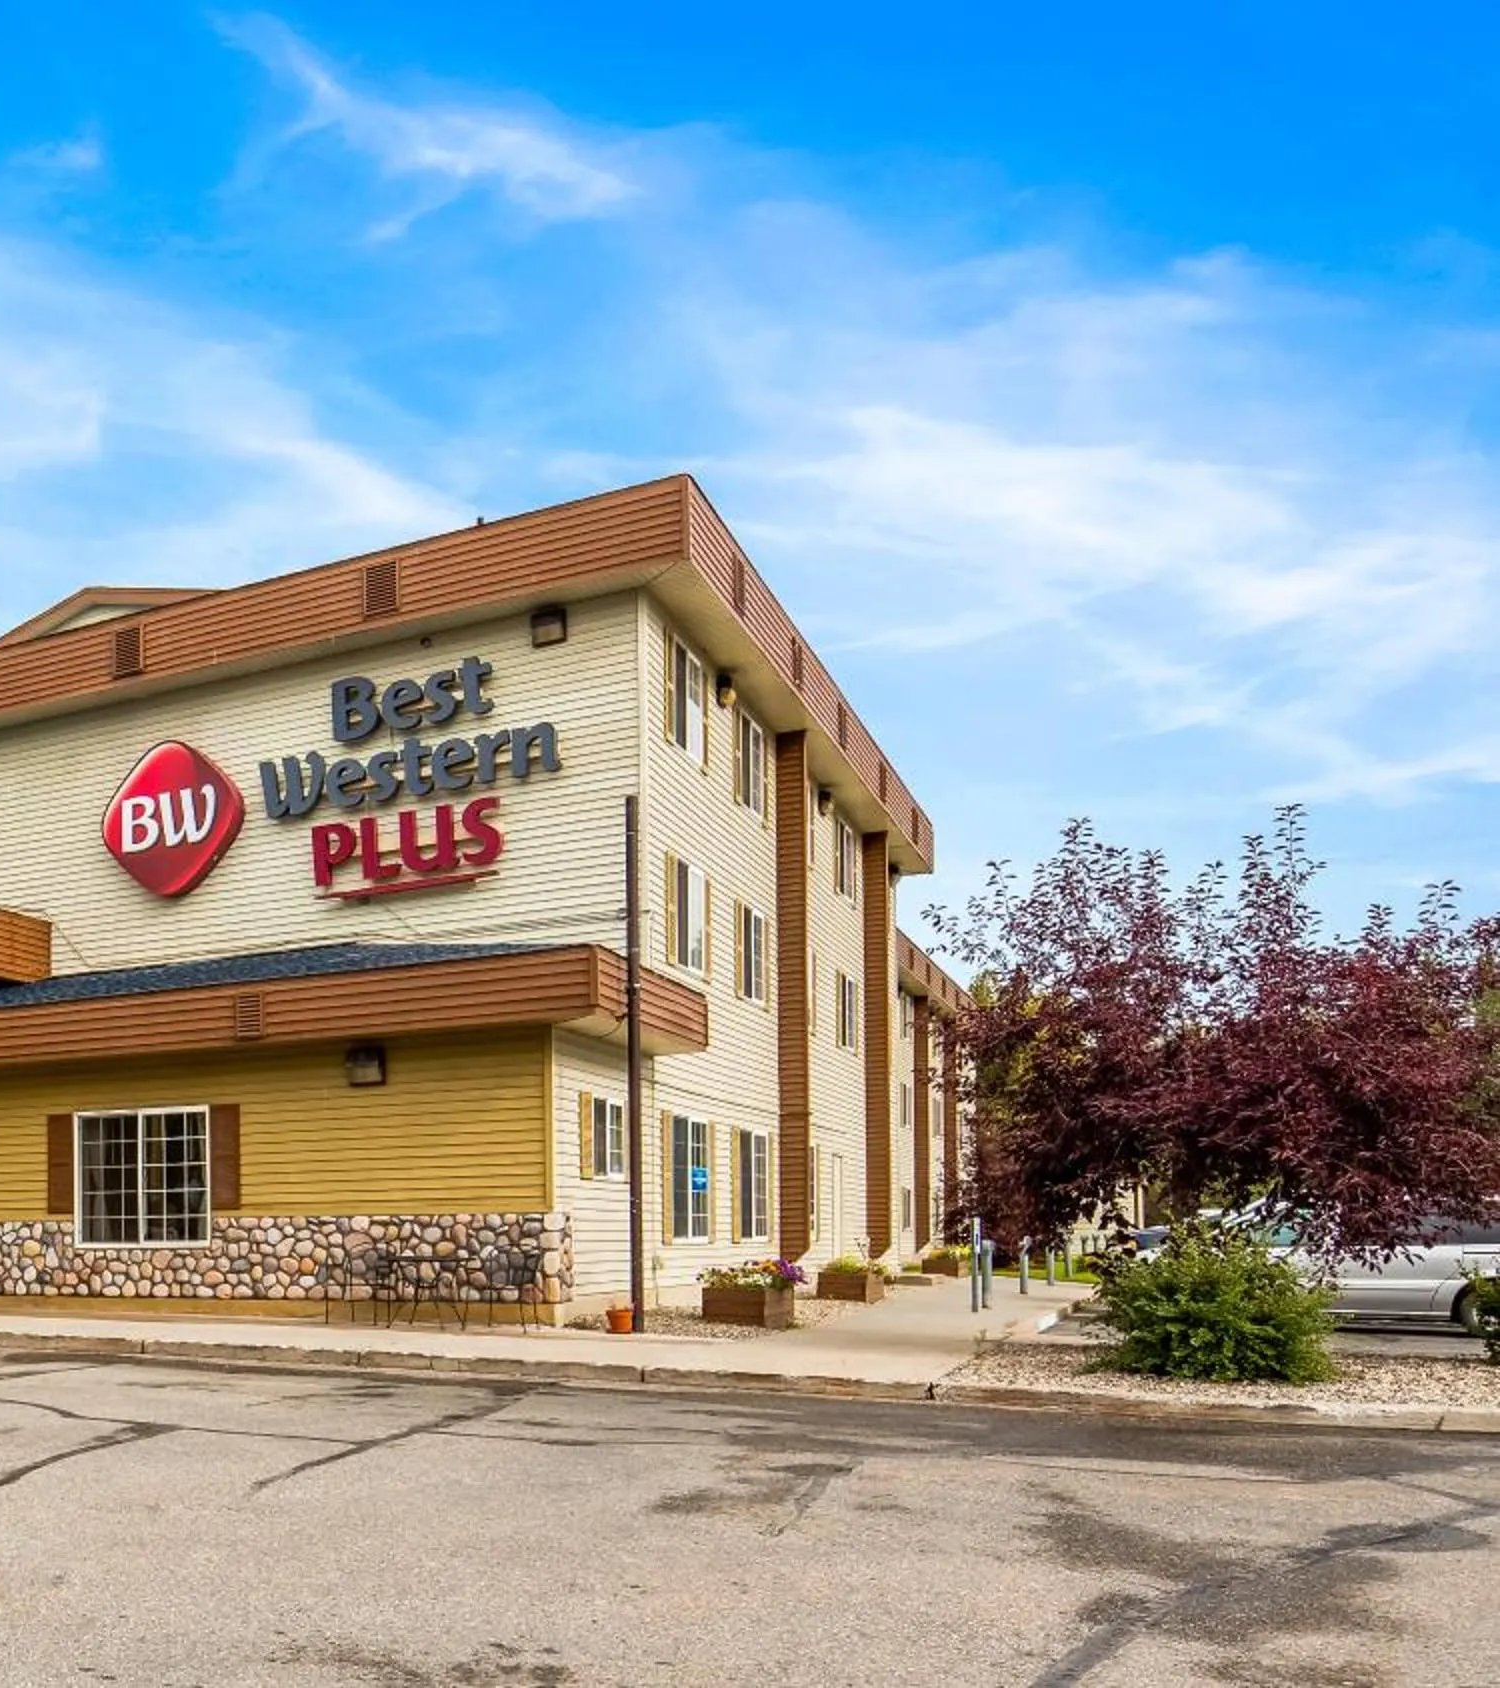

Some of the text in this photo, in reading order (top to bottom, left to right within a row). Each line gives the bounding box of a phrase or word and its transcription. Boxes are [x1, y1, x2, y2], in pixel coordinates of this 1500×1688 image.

[331, 656, 493, 742] Best
[258, 722, 562, 820] Western
[120, 783, 216, 853] BW
[311, 797, 504, 887] PLUS
